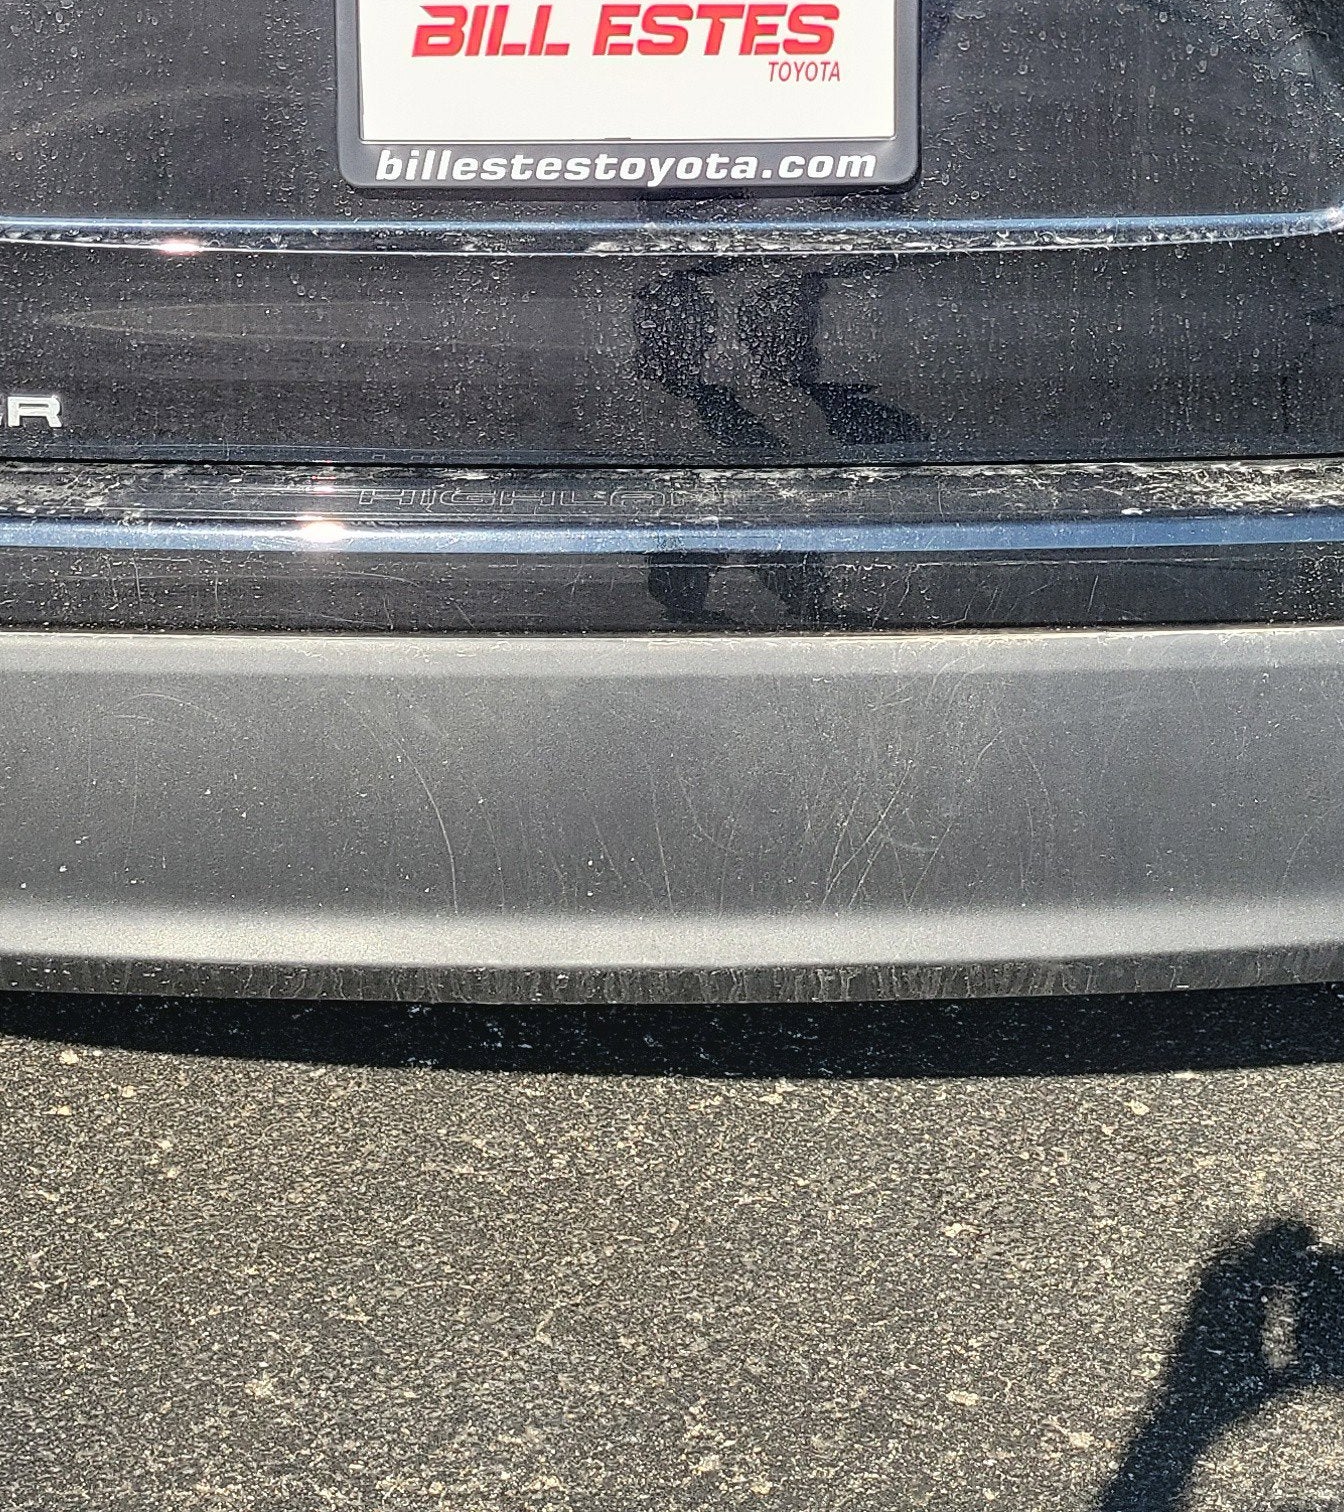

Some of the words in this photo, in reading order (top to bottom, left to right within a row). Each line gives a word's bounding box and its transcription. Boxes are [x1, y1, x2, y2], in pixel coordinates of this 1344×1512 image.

[412, 4, 569, 56] BILL
[591, 3, 841, 56] ESTES
[768, 60, 841, 83] TOYOTA
[374, 148, 877, 188] billestestoyota.com
